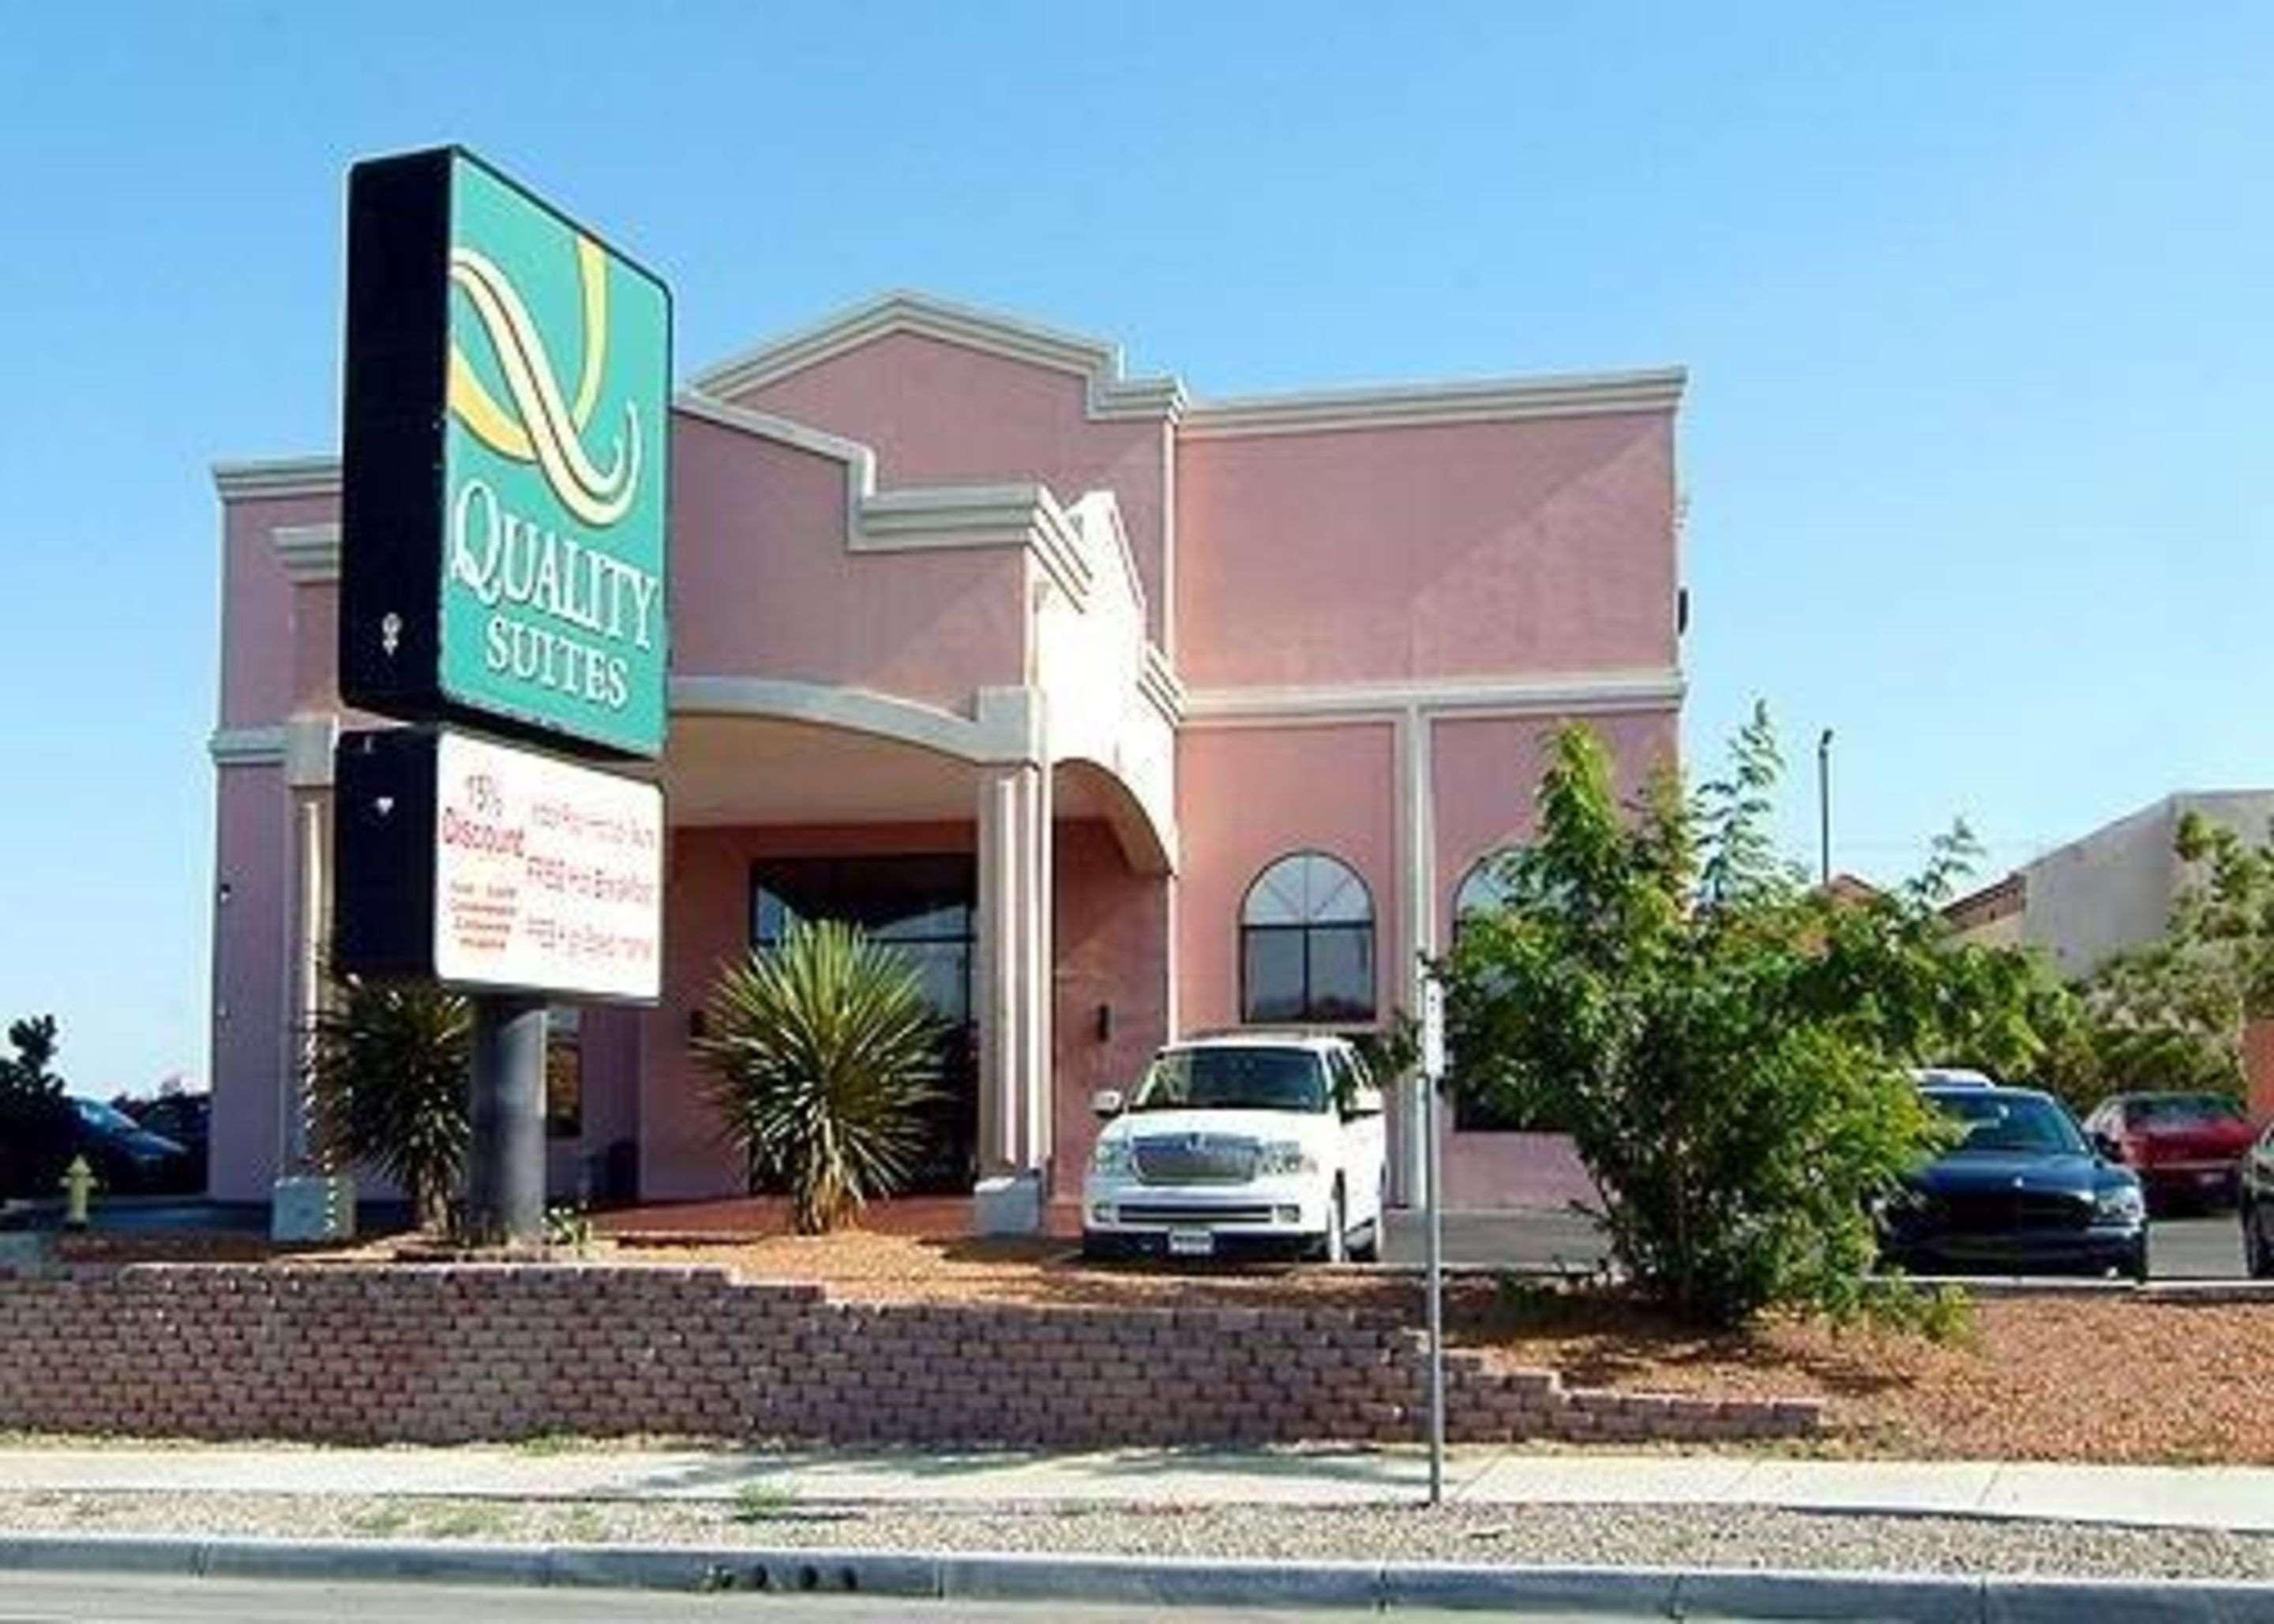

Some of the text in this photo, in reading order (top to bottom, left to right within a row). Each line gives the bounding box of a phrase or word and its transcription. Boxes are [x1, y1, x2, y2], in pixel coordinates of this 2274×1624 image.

[450, 478, 659, 650] QUALITY
[486, 614, 629, 708] SUITES
[443, 805, 525, 858] Discount
